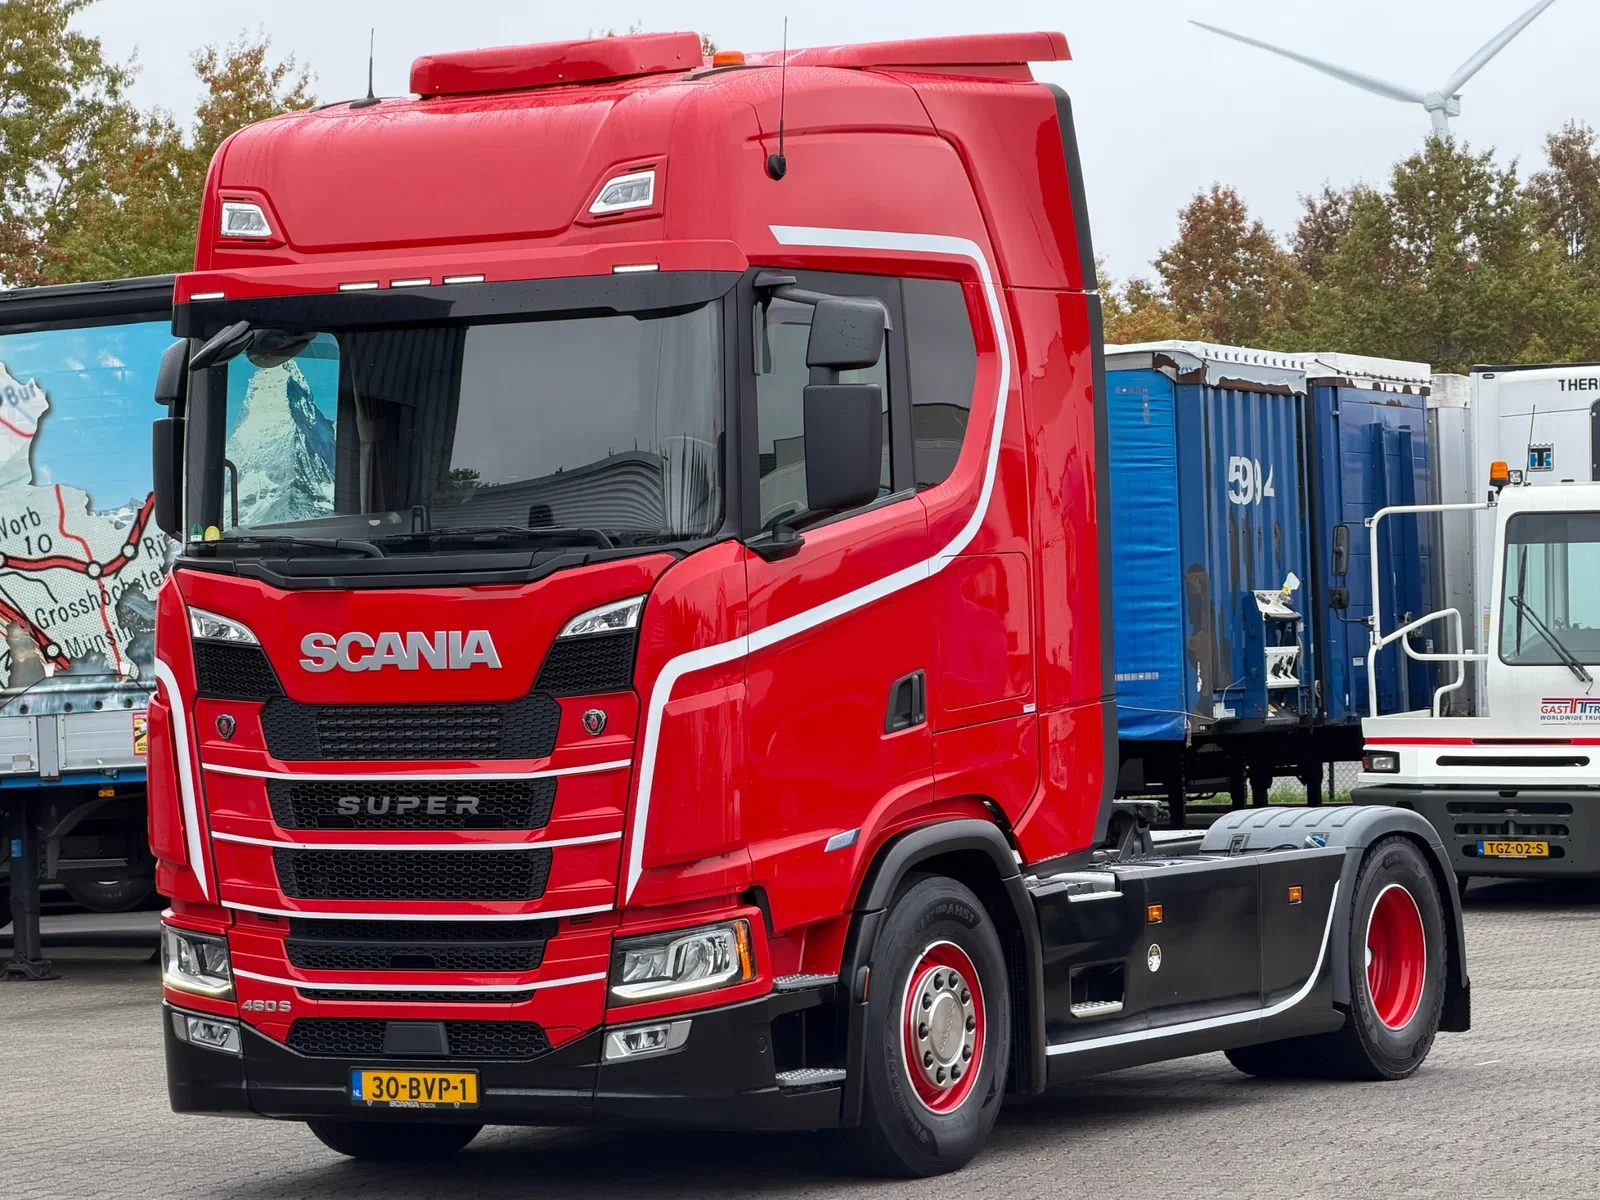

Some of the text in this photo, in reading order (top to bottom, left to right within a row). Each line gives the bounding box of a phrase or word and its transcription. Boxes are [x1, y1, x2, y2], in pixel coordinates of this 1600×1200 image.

[1558, 378, 1600, 391] THER
[25, 534, 52, 555] 10
[299, 630, 503, 673] SCANIA
[337, 796, 480, 815] SUPER
[1488, 843, 1544, 854] TGZ-02-S
[241, 999, 292, 1013] 460 S
[353, 1076, 467, 1101] NL 30-BVP-1
[389, 1100, 420, 1109] SCANIA
